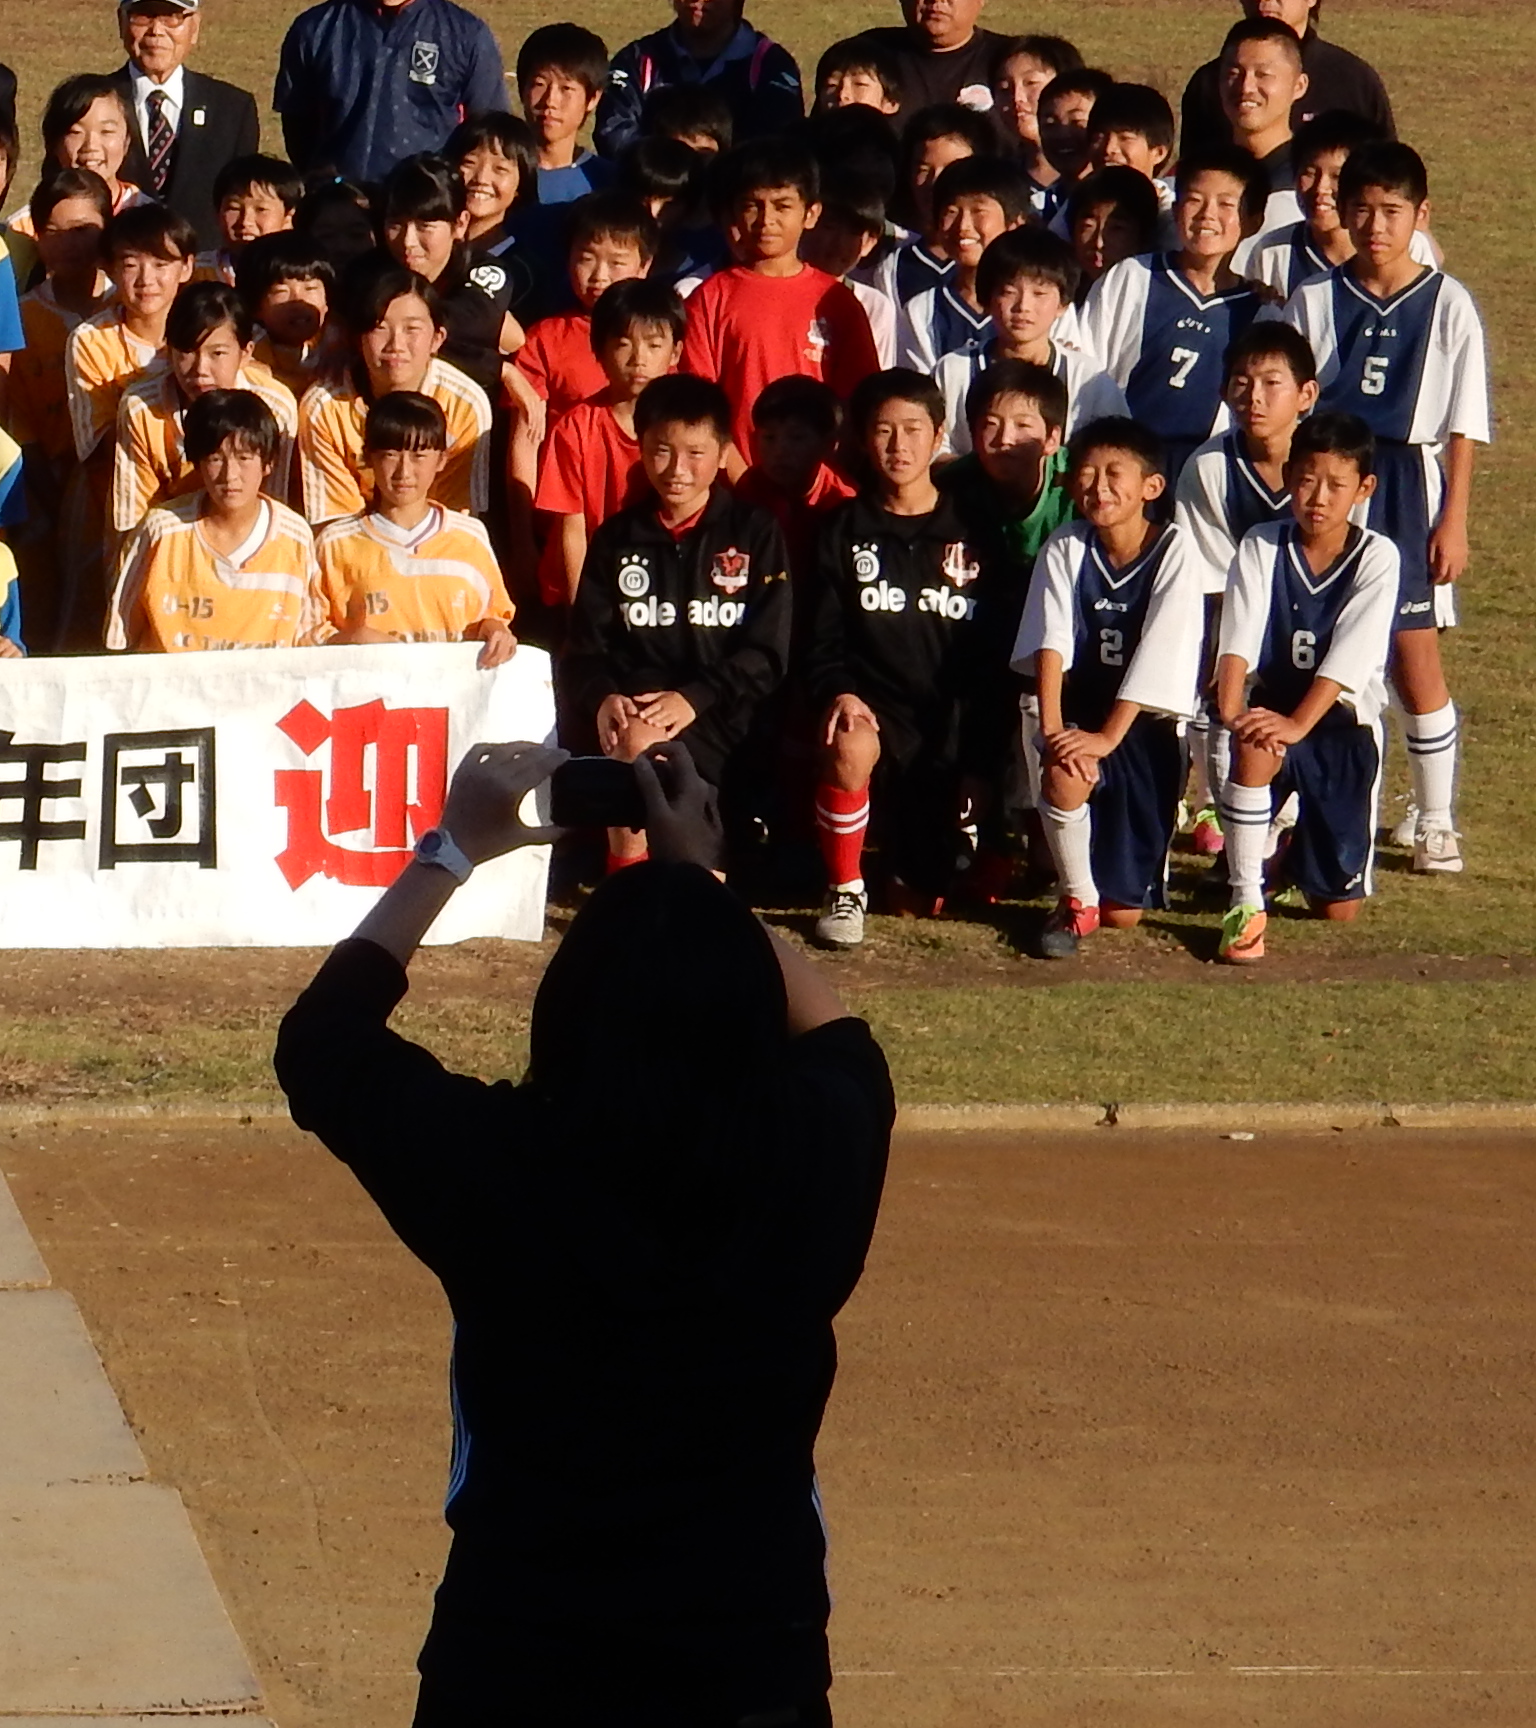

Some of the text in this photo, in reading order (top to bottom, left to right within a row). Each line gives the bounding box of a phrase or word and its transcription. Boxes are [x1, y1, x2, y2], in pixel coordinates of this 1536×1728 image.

[1169, 347, 1200, 388] 7
[1361, 356, 1389, 395] 5
[1100, 628, 1124, 667] 2
[1292, 629, 1317, 670] 6
[274, 698, 450, 893] 迎
